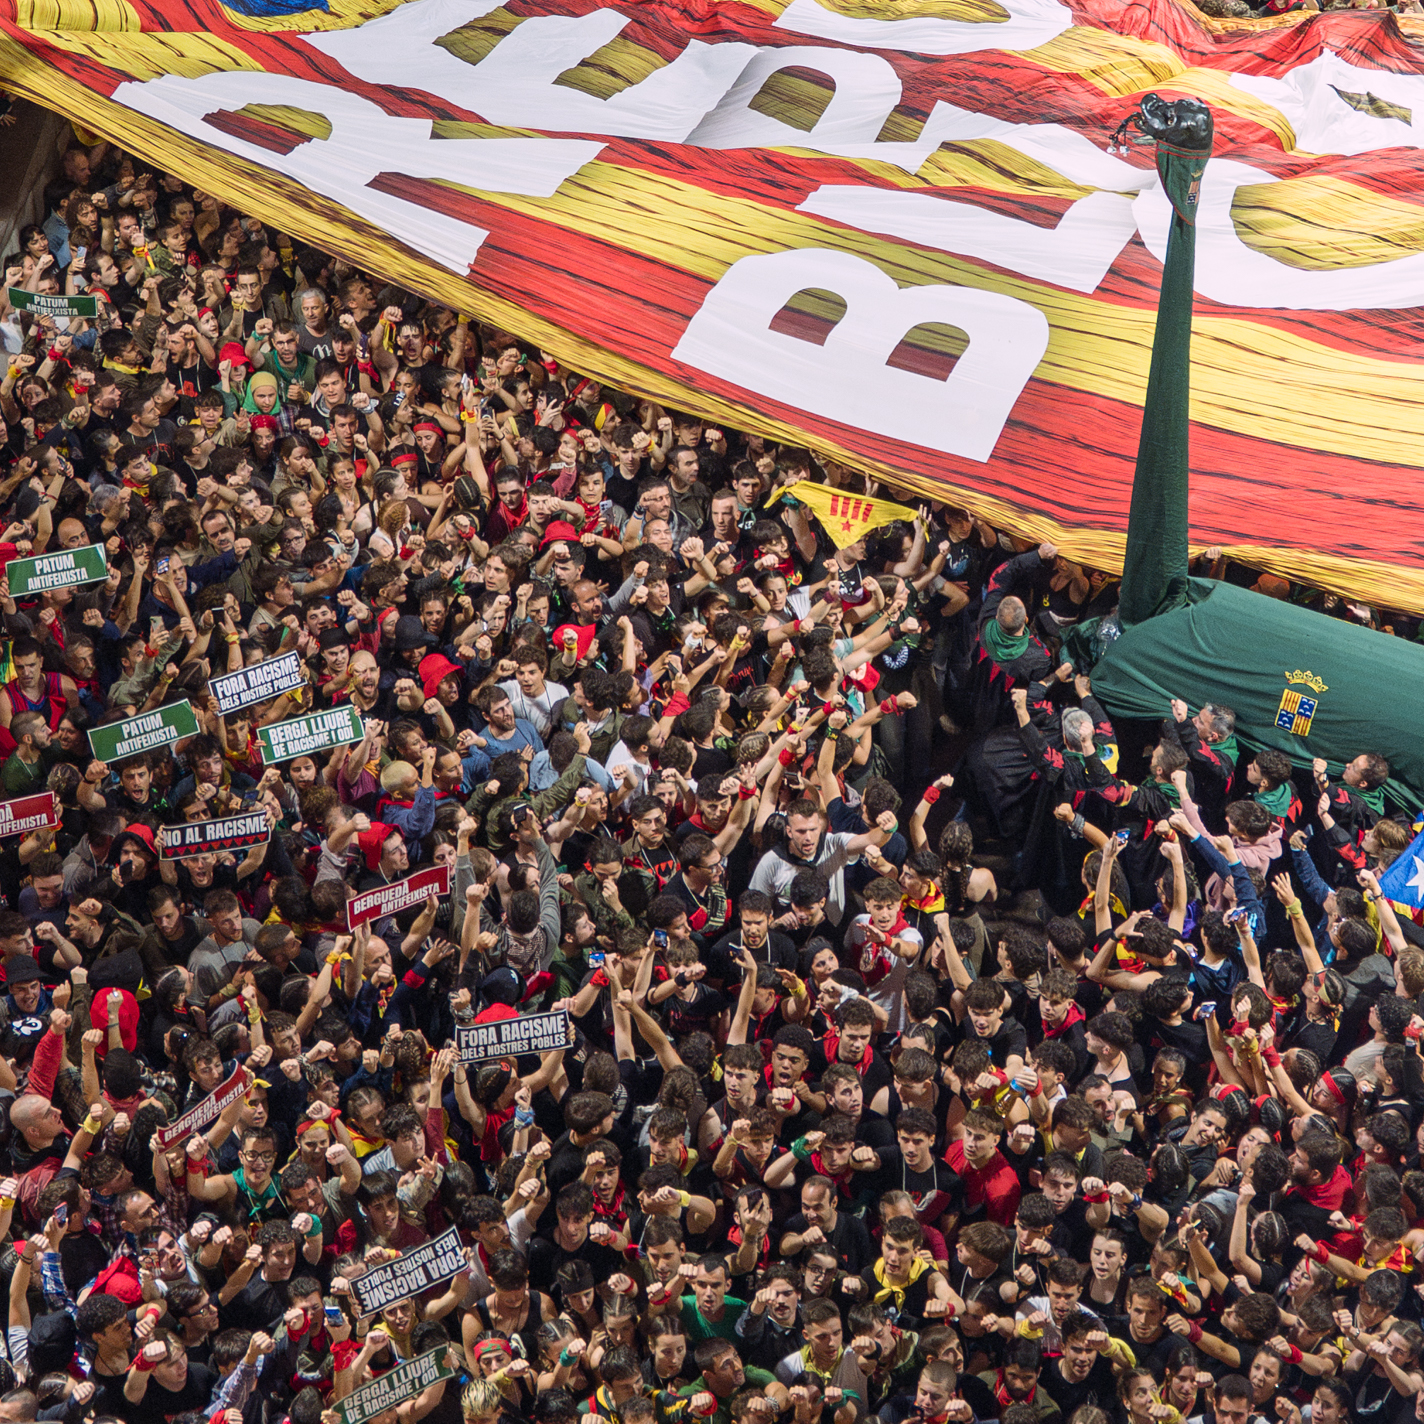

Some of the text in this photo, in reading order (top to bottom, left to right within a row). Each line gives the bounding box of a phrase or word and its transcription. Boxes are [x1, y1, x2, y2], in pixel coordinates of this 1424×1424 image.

[28, 567, 88, 590] ANTIFEIXISTA
[35, 554, 75, 574] PATUM
[215, 655, 299, 699] FORA RACISME
[219, 673, 301, 711] DELS NOSTRES POBLES
[116, 725, 178, 755] ANTIFEIXISTA
[122, 713, 163, 738] PATUM
[268, 709, 351, 745] BERGA LLIURE
[273, 743, 288, 757] DE
[288, 732, 332, 754] RACISME
[339, 725, 354, 741] ODI
[164, 816, 267, 847] NO AL RACISME
[381, 882, 439, 914] ANTIFEIXISTA
[460, 1014, 565, 1047] FORA RACISME
[461, 1032, 566, 1060] DELS NOSTRES POBLES
